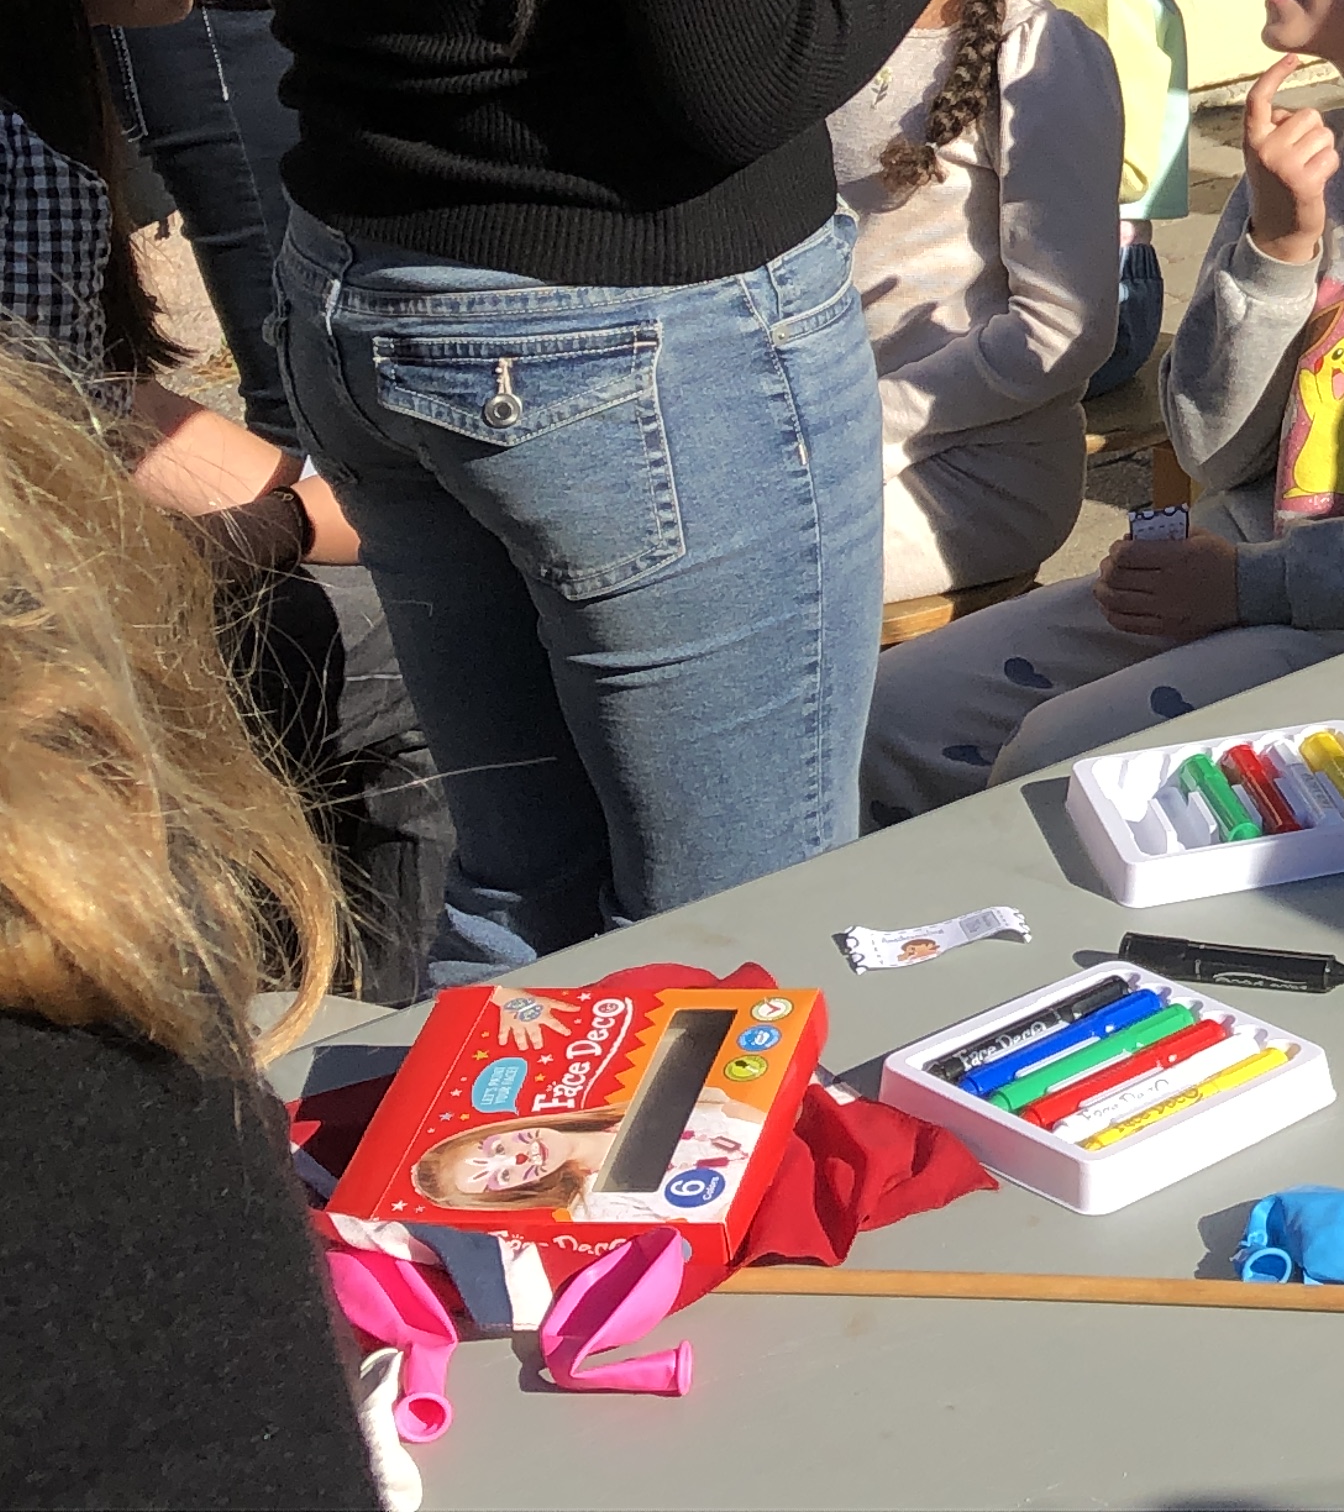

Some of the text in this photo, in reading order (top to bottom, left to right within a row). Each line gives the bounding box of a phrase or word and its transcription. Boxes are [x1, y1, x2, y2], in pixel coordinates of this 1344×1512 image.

[953, 1043, 997, 1072] Face
[531, 1061, 592, 1113] Face
[669, 1178, 706, 1197] 6
